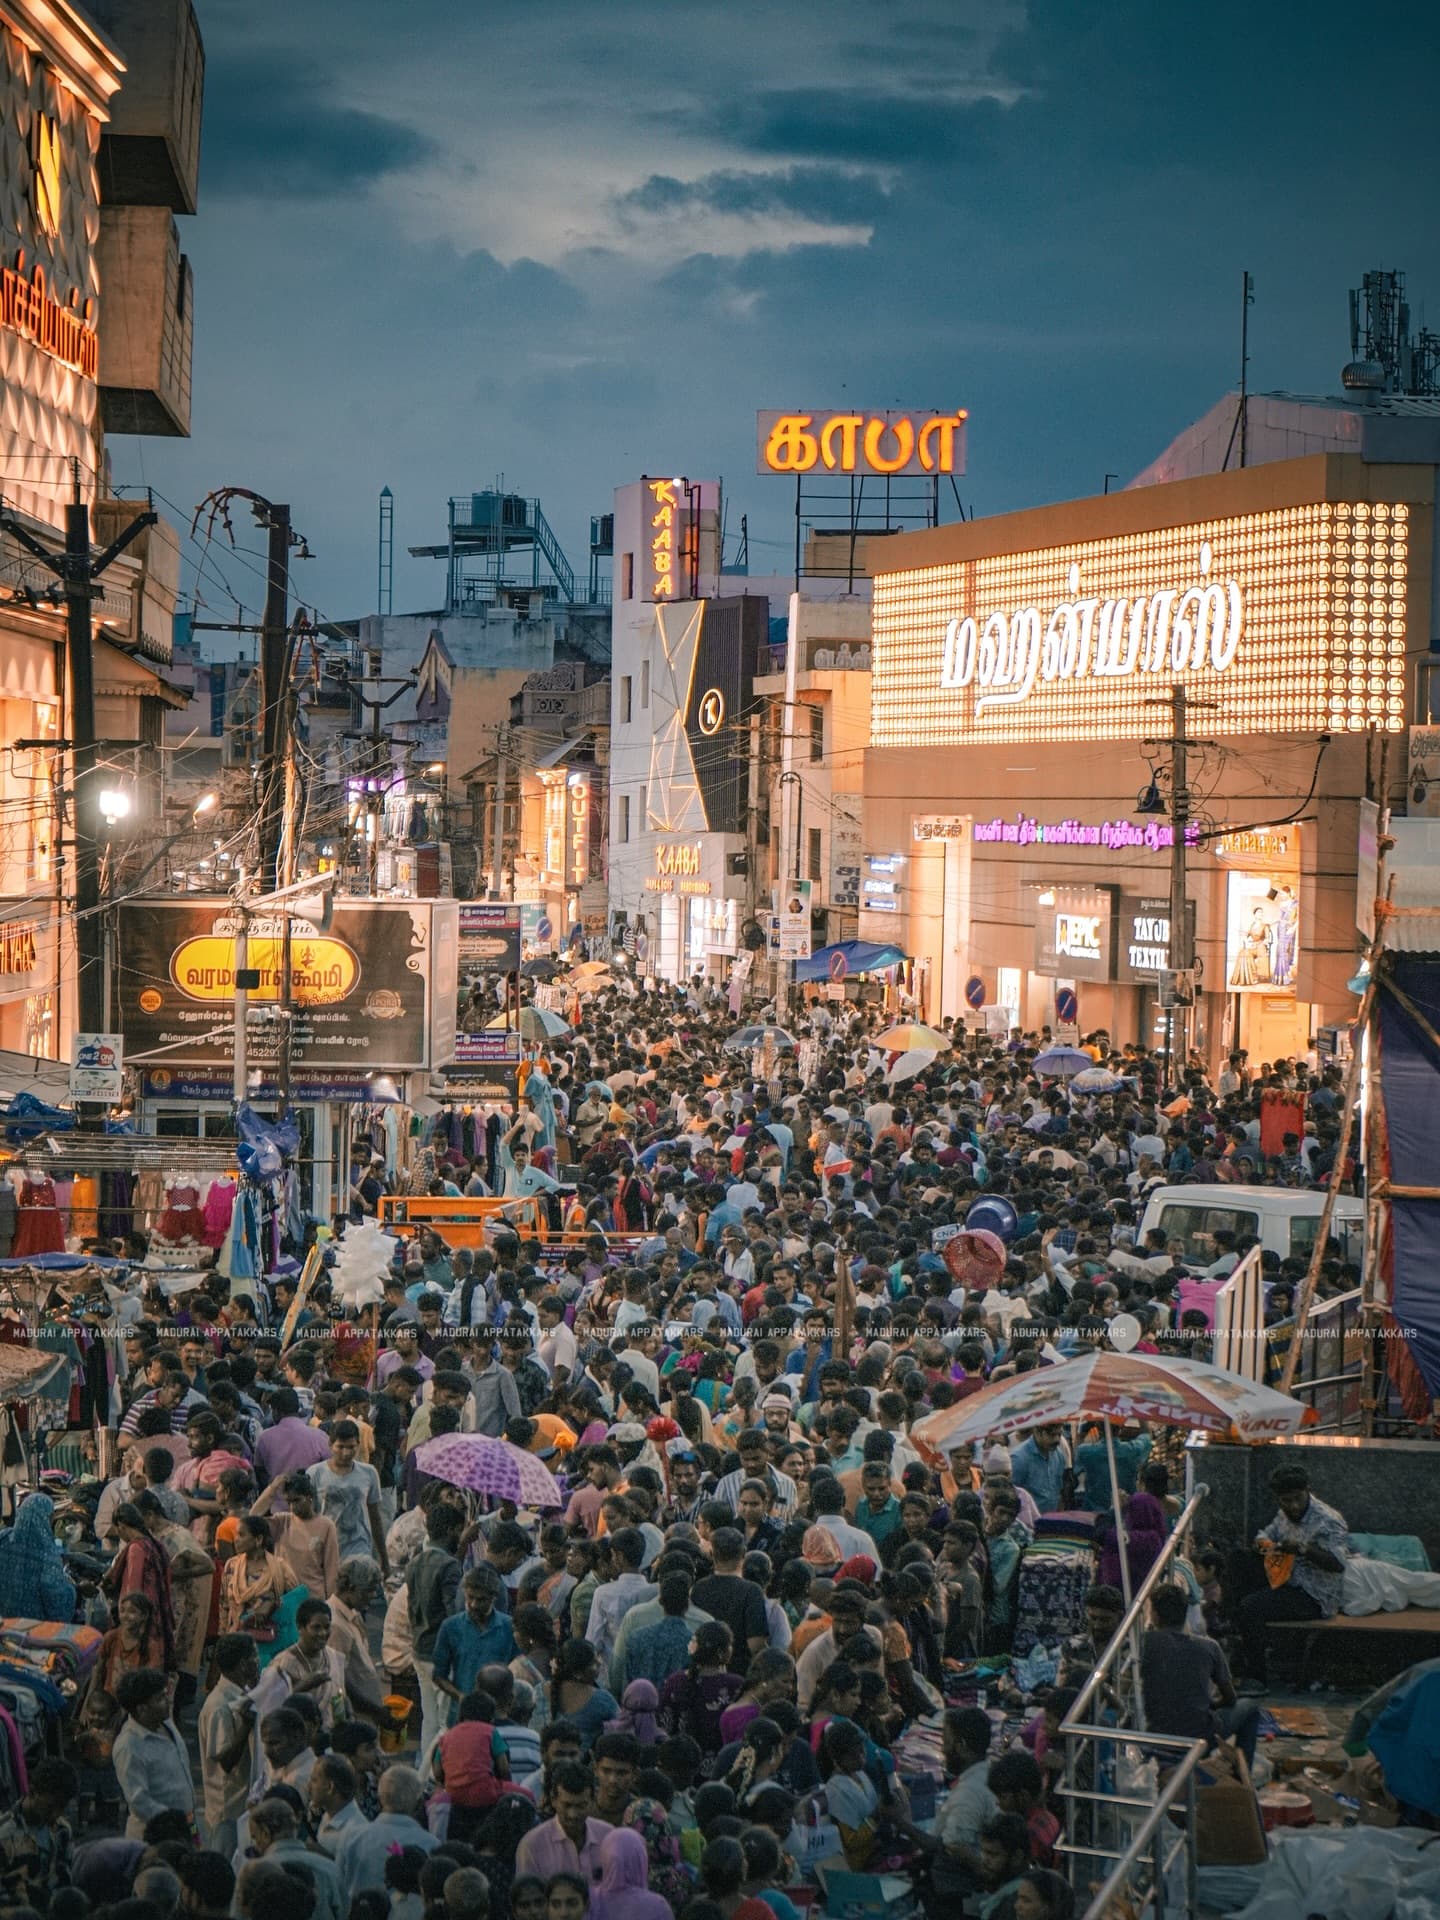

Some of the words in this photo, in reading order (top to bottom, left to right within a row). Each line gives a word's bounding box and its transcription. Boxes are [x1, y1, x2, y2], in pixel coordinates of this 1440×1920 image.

[765, 415, 962, 472] காபா
[649, 480, 678, 596] KAABA
[571, 783, 587, 884] OUTFIT
[655, 844, 701, 876] KAABA
[1128, 945, 1170, 970] TEXTIL
